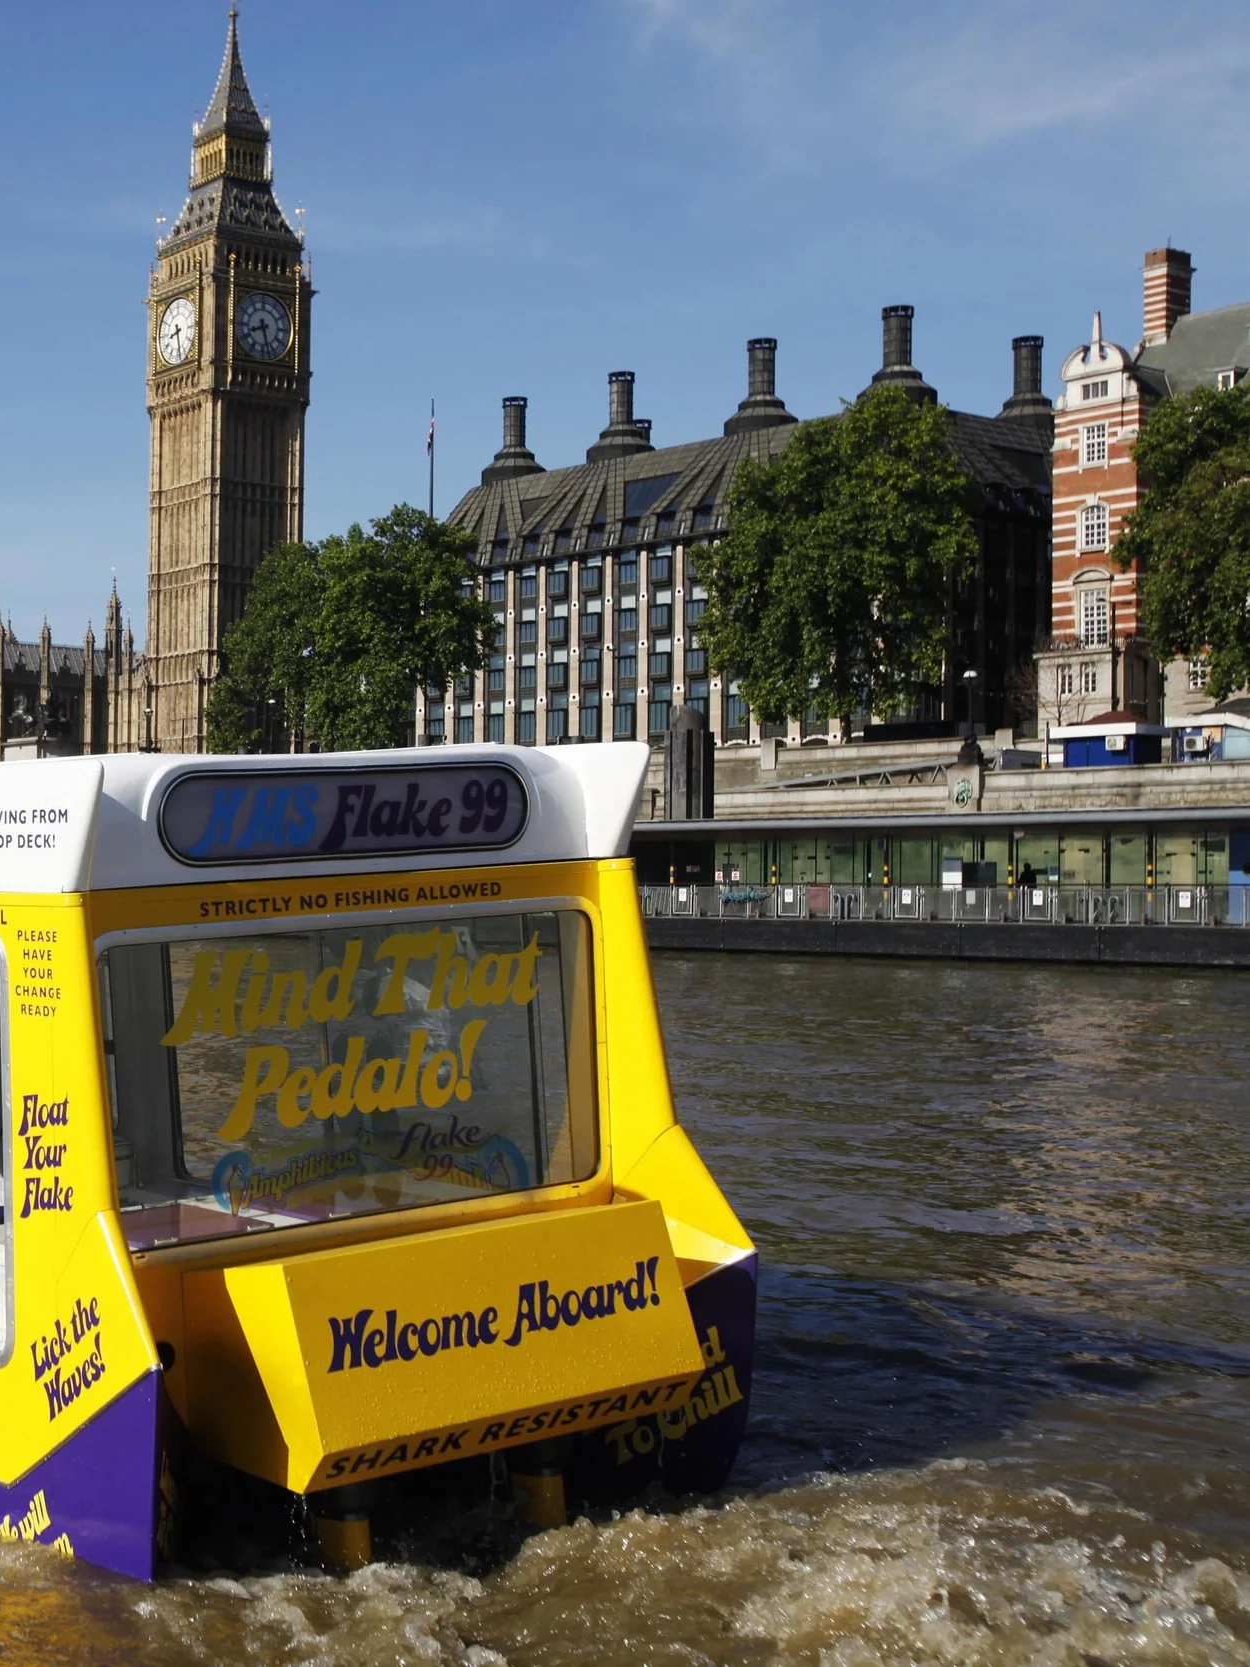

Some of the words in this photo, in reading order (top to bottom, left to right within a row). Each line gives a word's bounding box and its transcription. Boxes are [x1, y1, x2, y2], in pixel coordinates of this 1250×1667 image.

[31, 808, 69, 824] FROM
[185, 784, 320, 858] HMS
[318, 782, 453, 854] Flake
[460, 778, 509, 835] 99
[17, 834, 56, 849] DECK!
[199, 896, 292, 919] STRICTLY
[299, 893, 328, 910] NO
[334, 887, 410, 908] FISHING
[416, 881, 502, 903] ALLOWED
[17, 930, 58, 943] PLEASE
[22, 949, 52, 961] HAVE
[15, 984, 62, 1000] CHANGE
[22, 967, 54, 981] YOUR
[159, 939, 363, 1046] Mind
[373, 926, 544, 1016] That
[20, 1003, 57, 1018] READY
[217, 1020, 488, 1141] Pedalo!
[17, 1092, 69, 1136] Float
[22, 1135, 67, 1171] Your
[391, 1114, 483, 1160] flake
[423, 1154, 452, 1181] 99
[19, 1176, 74, 1219] Flake
[327, 1307, 501, 1374] Welcome
[502, 1256, 660, 1347] Aboard!
[30, 1319, 72, 1383] Lick
[70, 1296, 100, 1345] the
[43, 1331, 106, 1423] Waves!
[325, 1429, 473, 1480] SHARK
[479, 1380, 689, 1446] RESISTANT
